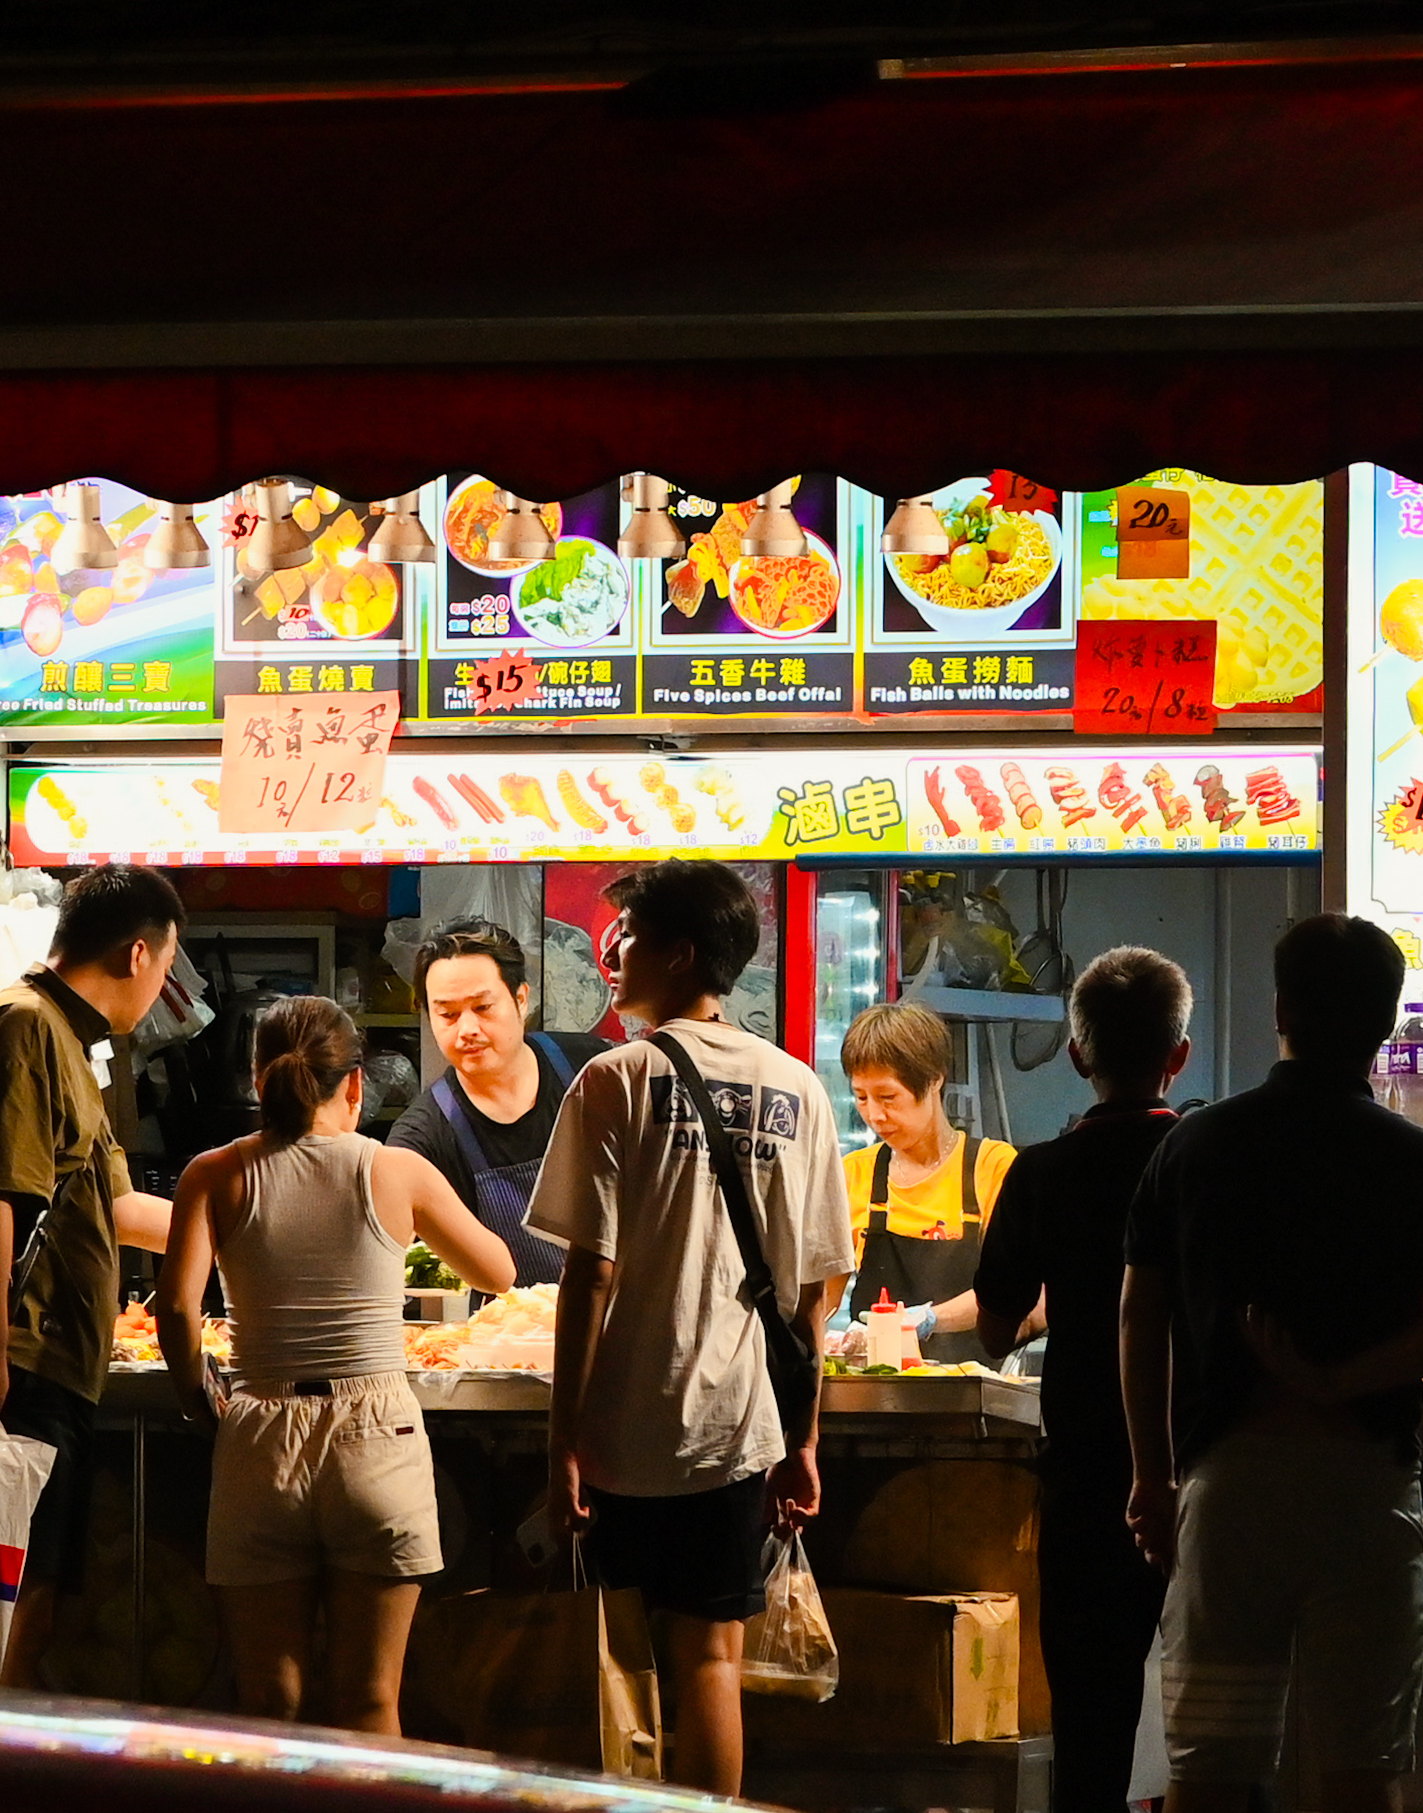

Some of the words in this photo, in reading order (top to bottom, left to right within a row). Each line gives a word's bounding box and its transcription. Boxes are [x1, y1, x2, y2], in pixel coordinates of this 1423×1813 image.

[231, 512, 258, 541] $1
[470, 595, 510, 615] $20
[470, 615, 510, 635] $25
[39, 659, 173, 694] 煎釀三寶
[256, 663, 376, 694] 魚蛋燒賣
[475, 662, 526, 703] $15
[689, 657, 807, 688] 五香牛雜
[577, 684, 610, 700] Soup
[653, 689, 691, 703] Five
[693, 689, 752, 706] Spices
[754, 688, 795, 703] Beef
[798, 686, 842, 702] Offal
[870, 687, 907, 703] Fish
[909, 688, 955, 702] Balls
[957, 686, 995, 701] with
[998, 684, 1070, 700] Noodles
[22, 697, 63, 712] Fried
[66, 697, 124, 713] Stuffed
[127, 698, 208, 713] Treasures
[560, 696, 582, 709] Fin
[584, 696, 621, 711] Soup
[918, 824, 940, 837] $10
